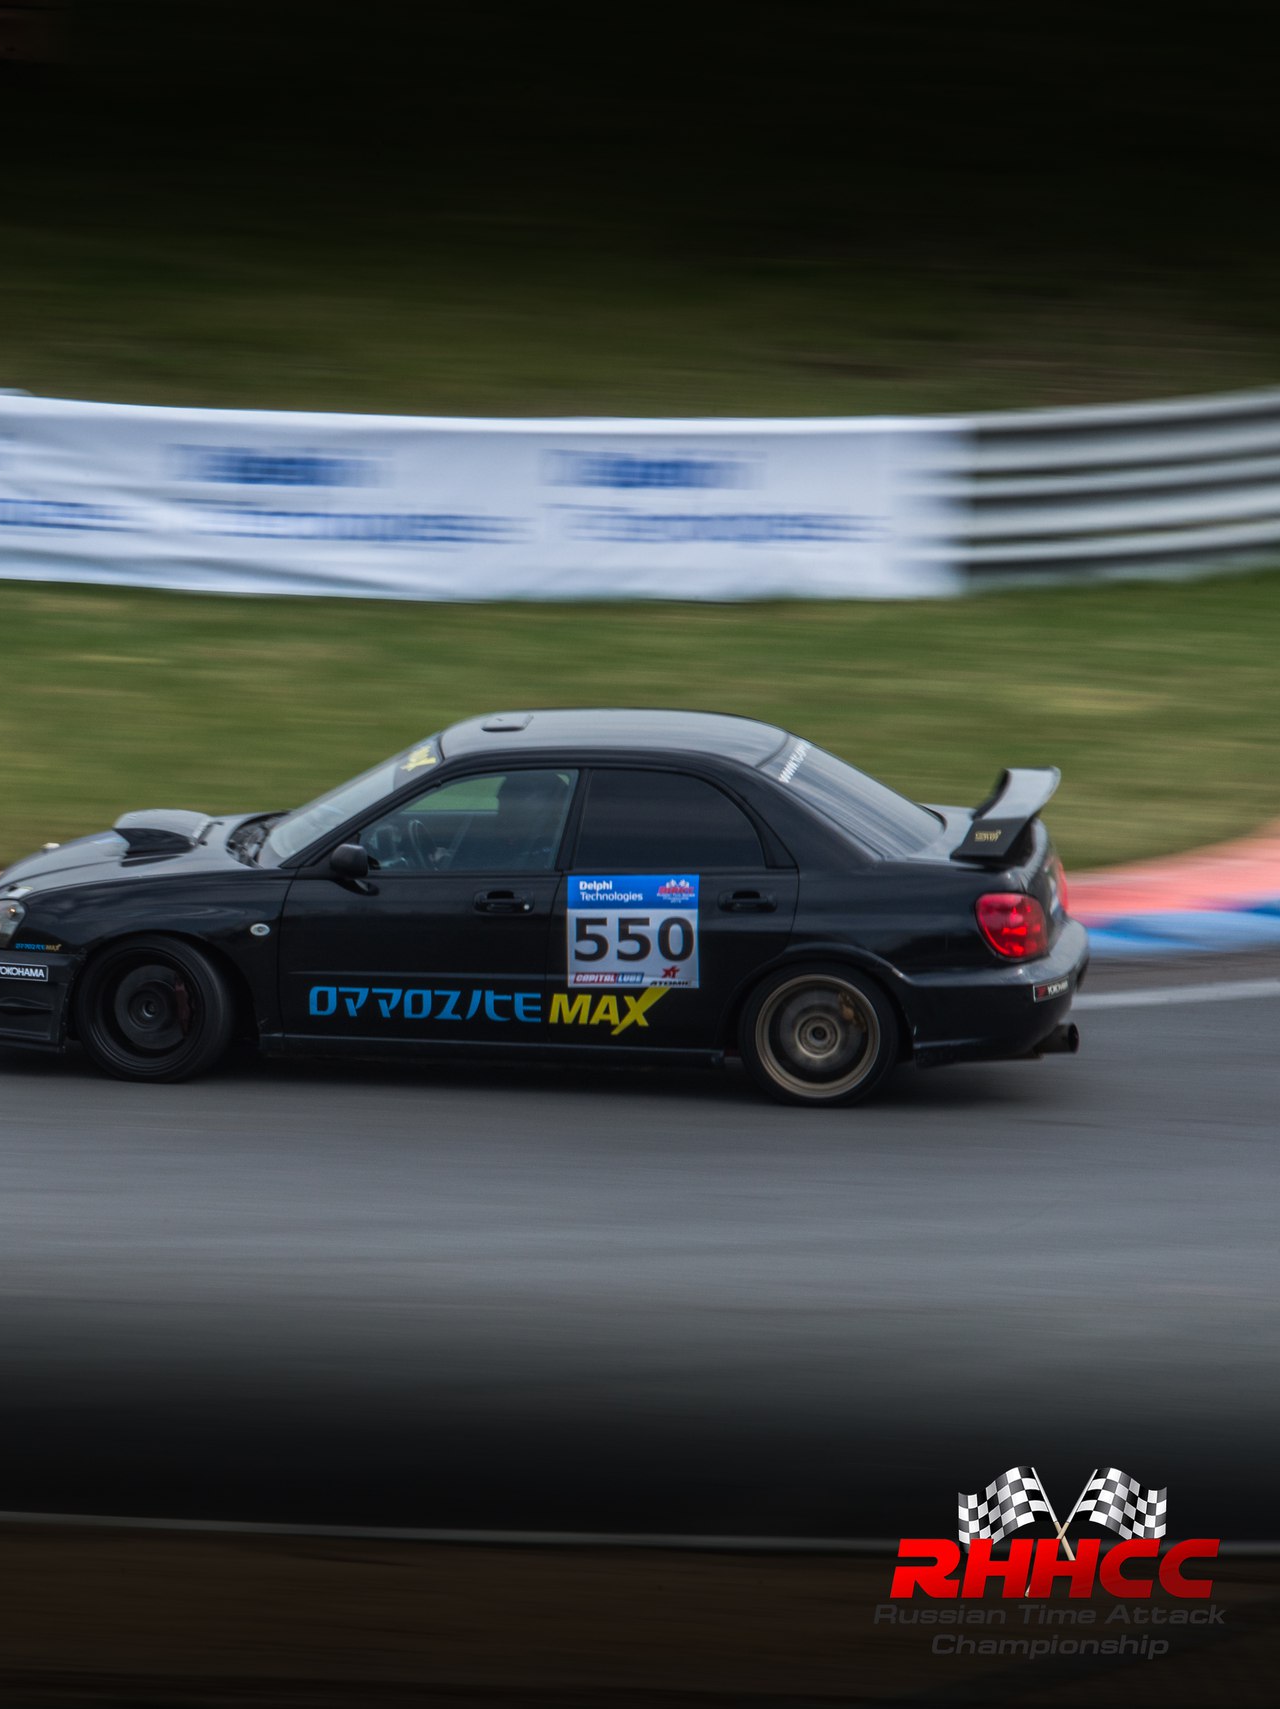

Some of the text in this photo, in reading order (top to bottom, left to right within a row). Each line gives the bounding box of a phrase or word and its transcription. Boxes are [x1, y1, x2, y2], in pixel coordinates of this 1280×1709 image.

[579, 880, 613, 892] Delphi
[580, 891, 644, 902] Technologies
[573, 916, 695, 962] 550
[549, 986, 671, 1035] MAX
